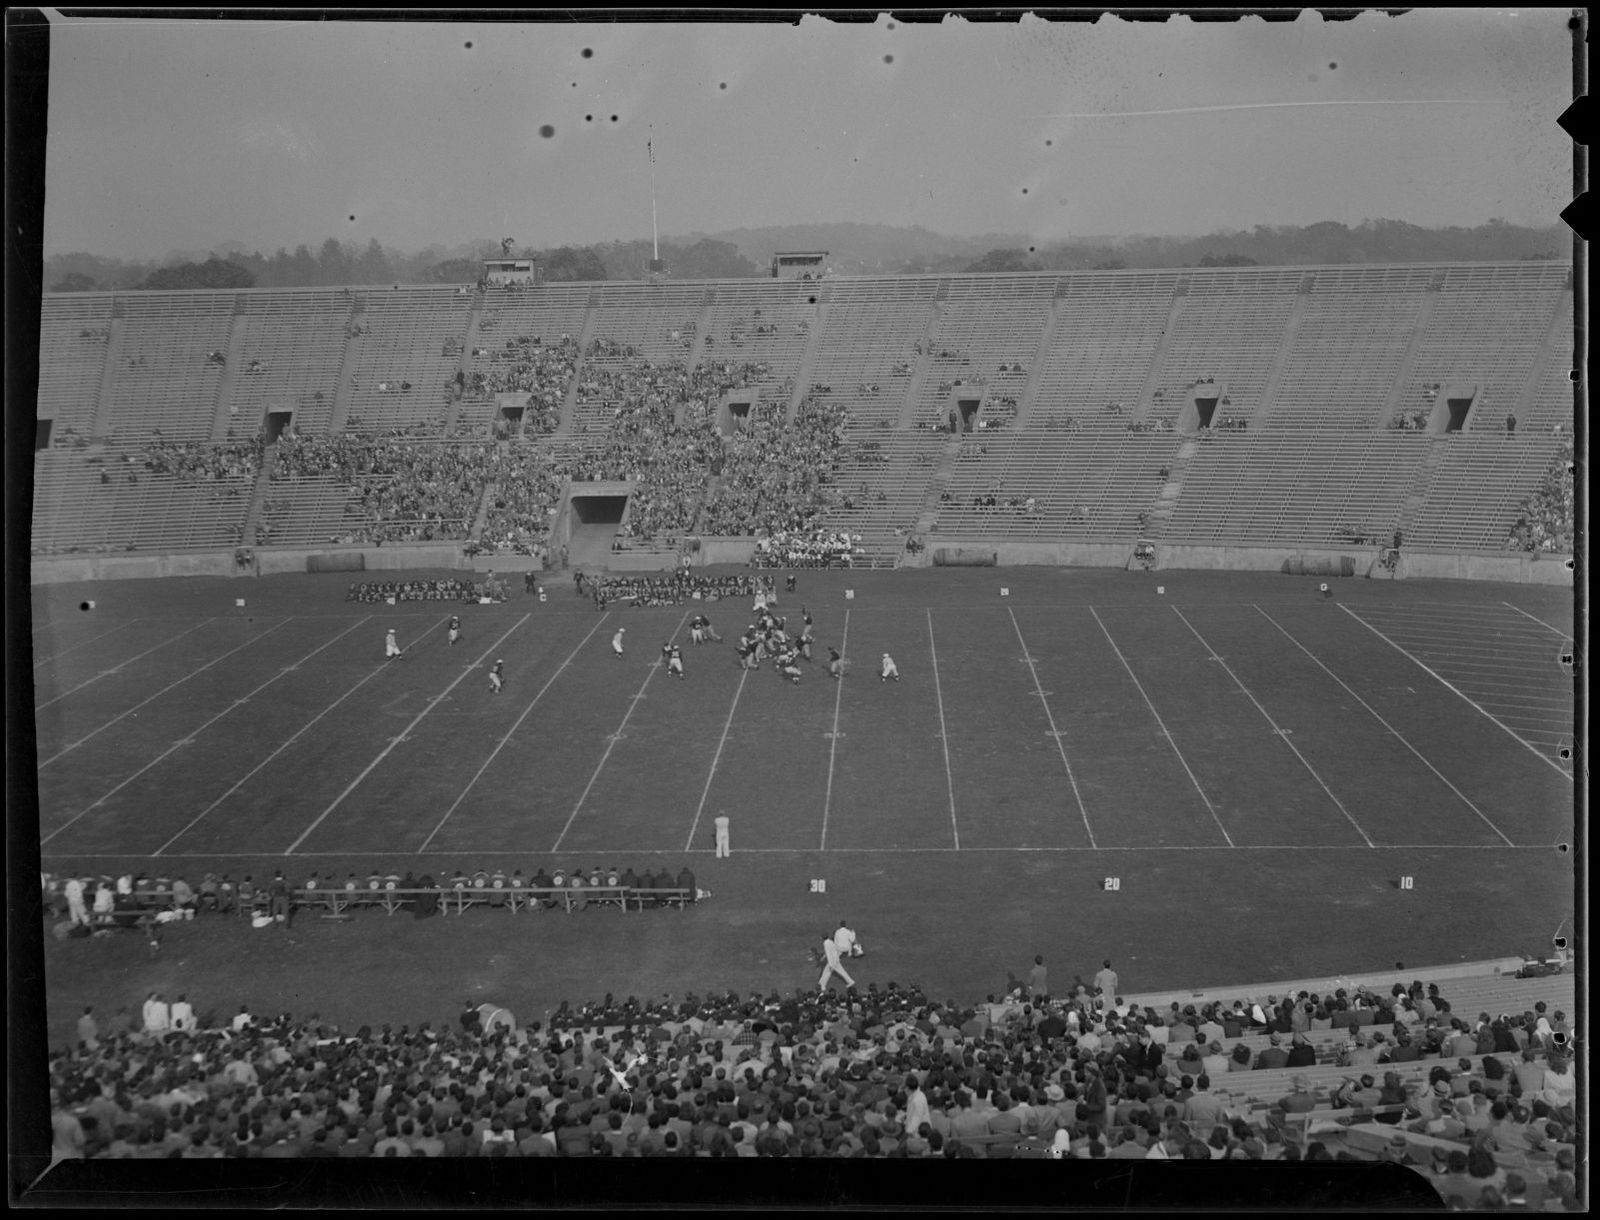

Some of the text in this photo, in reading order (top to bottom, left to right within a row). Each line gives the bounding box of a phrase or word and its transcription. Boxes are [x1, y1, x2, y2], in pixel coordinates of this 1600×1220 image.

[810, 879, 826, 893] 30
[1104, 877, 1120, 891] 20
[1401, 876, 1414, 890] 10
